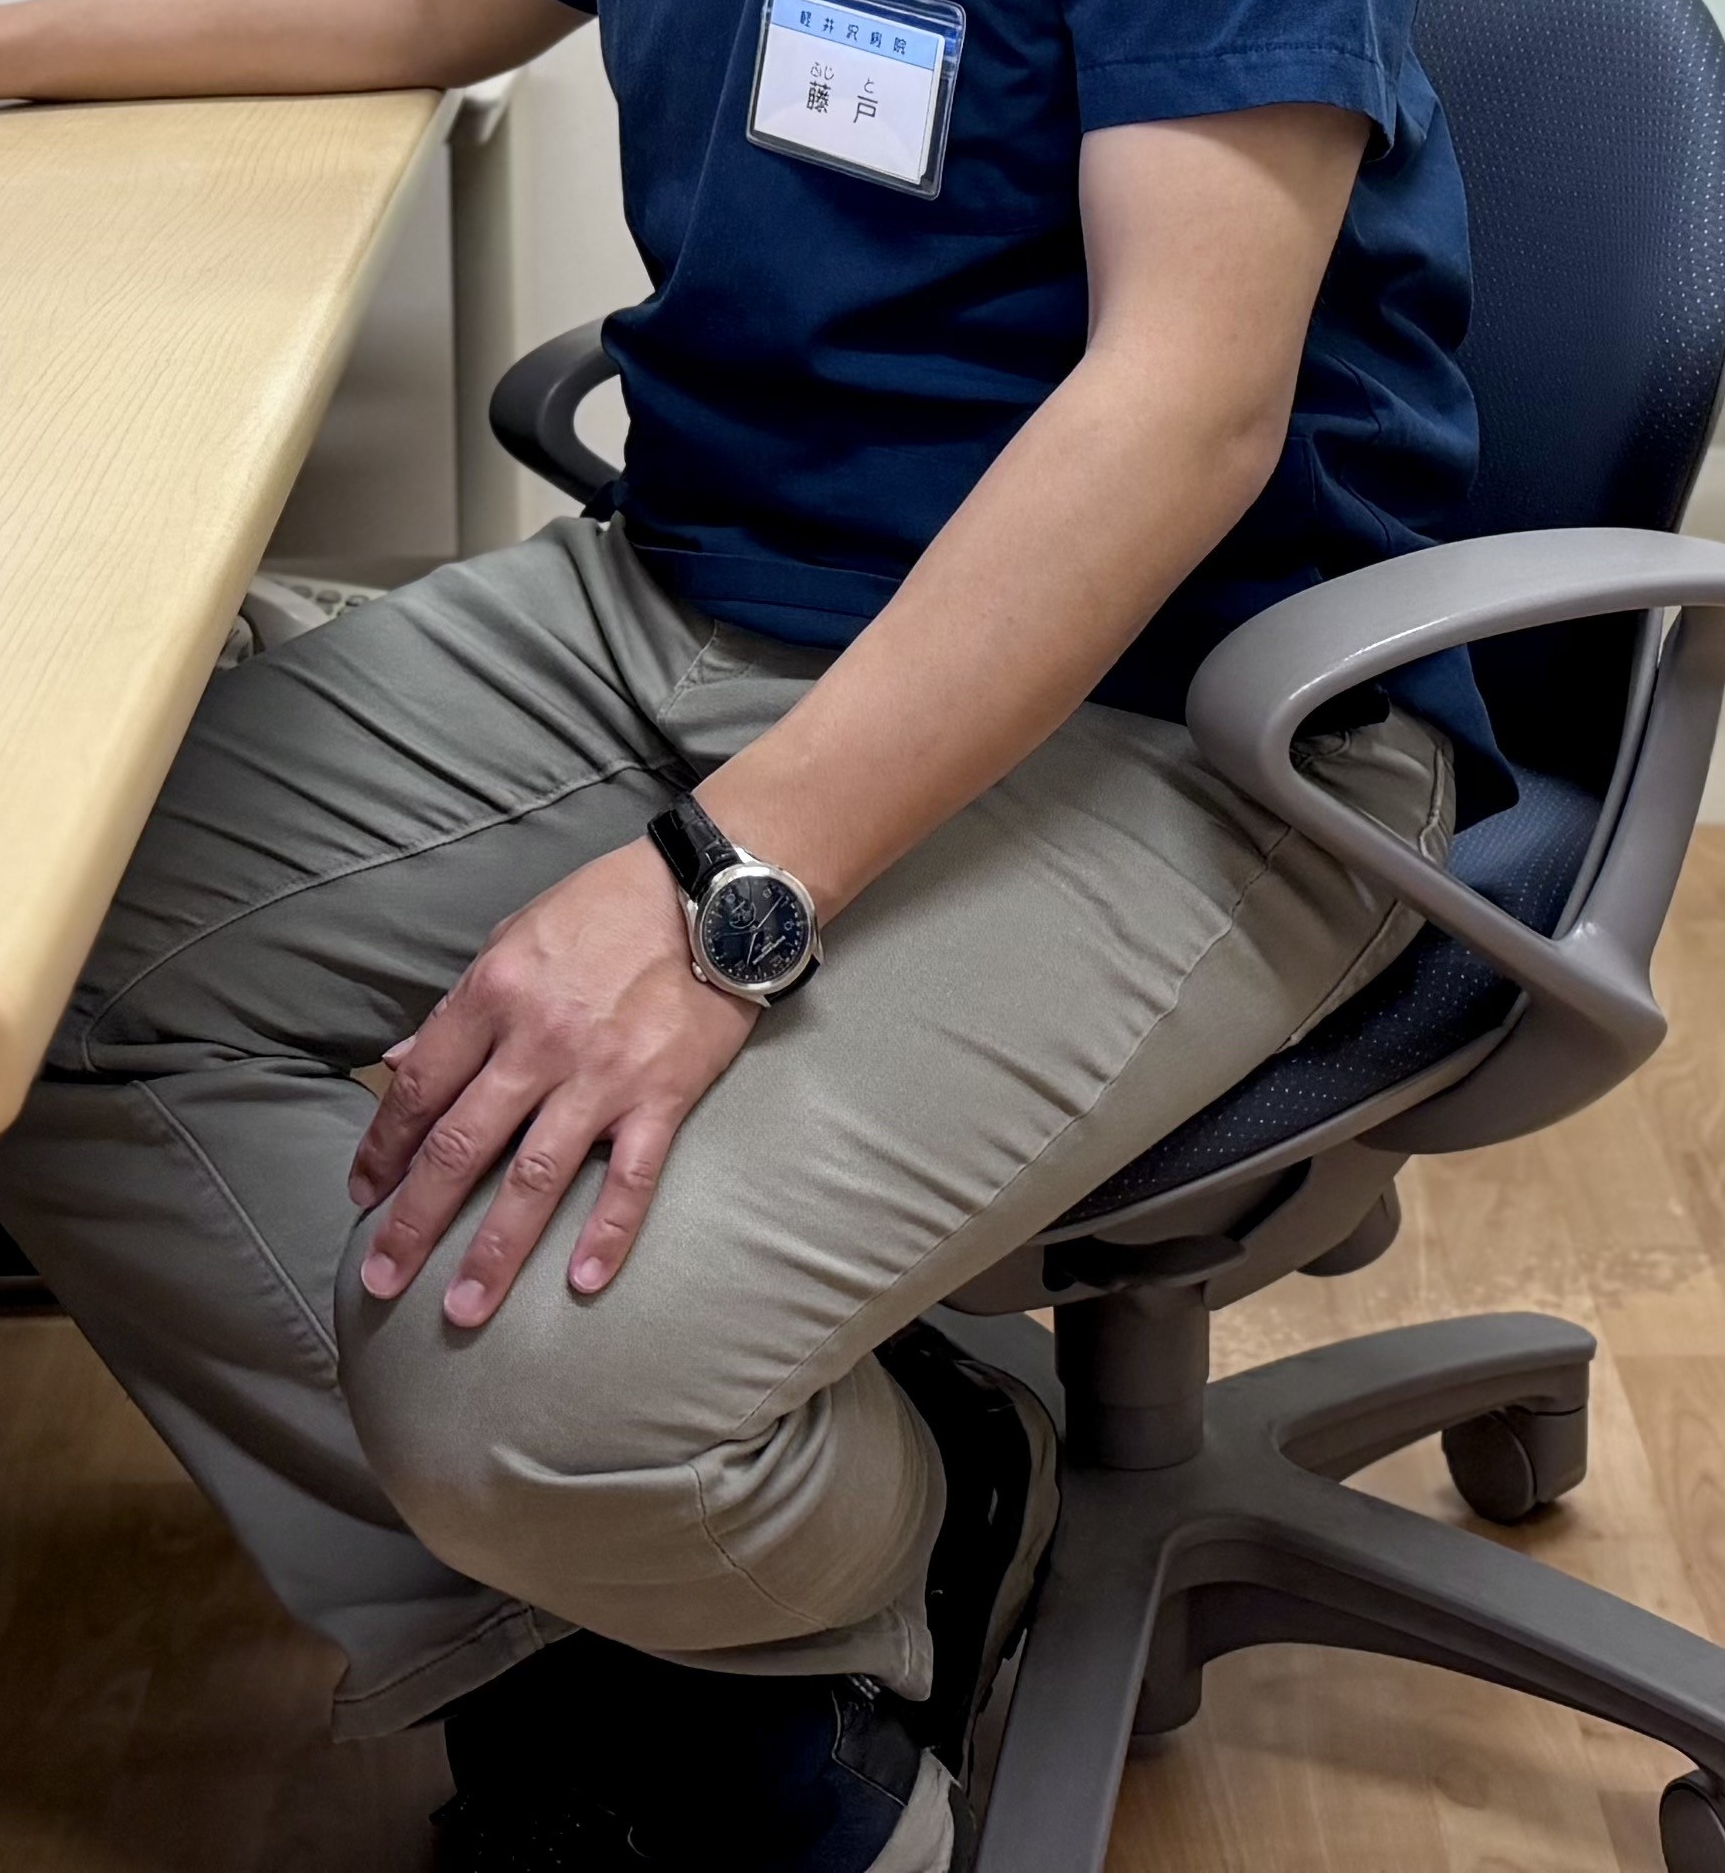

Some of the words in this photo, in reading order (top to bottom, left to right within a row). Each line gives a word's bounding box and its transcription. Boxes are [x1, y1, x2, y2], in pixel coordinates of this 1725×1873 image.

[800, 10, 907, 55] 軽井沢病院
